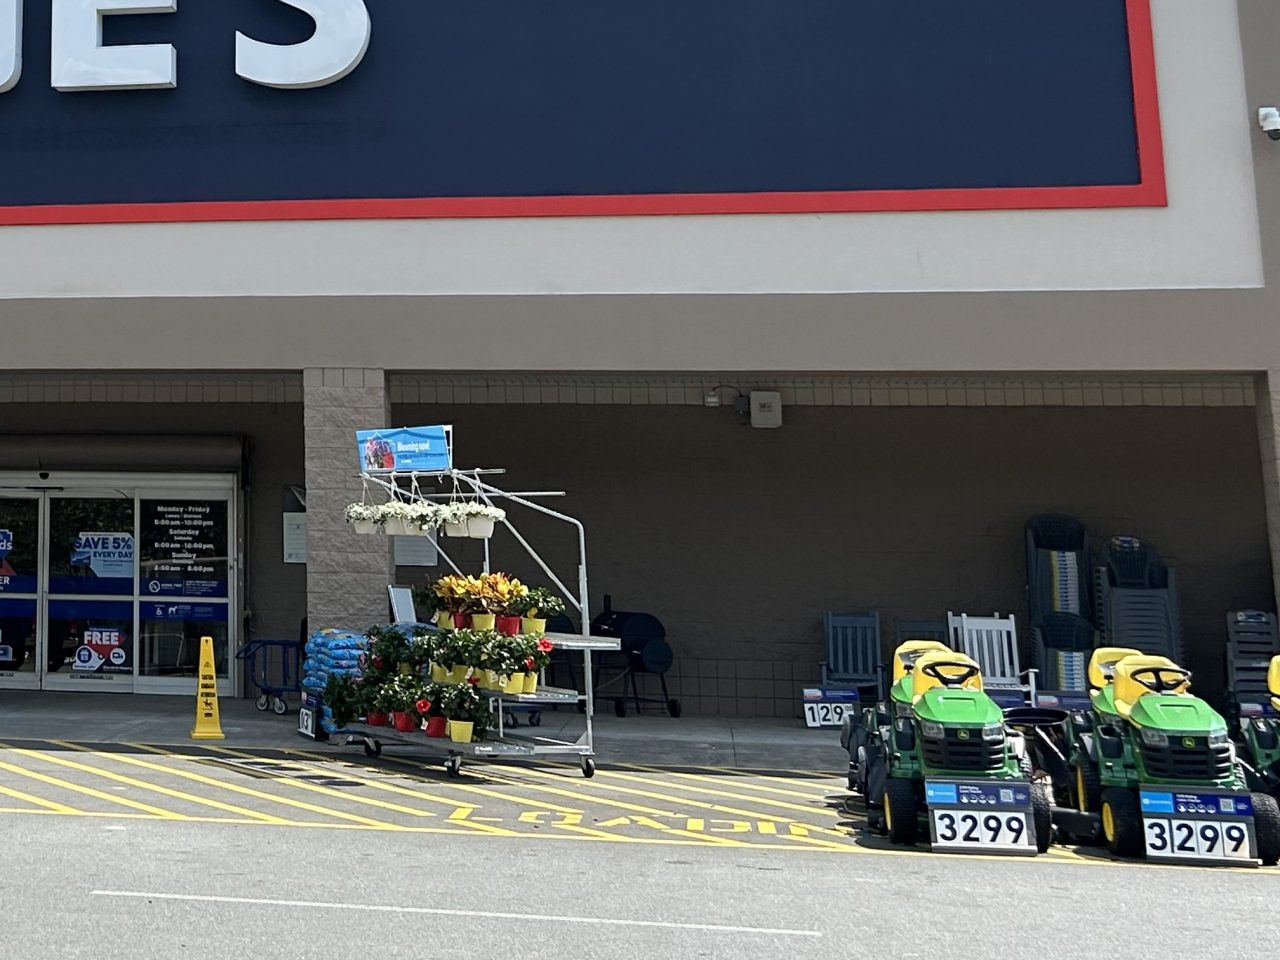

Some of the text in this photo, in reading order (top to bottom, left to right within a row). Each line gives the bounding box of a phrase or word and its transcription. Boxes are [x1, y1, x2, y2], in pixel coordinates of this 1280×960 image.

[75, 537, 132, 550] SAVE 5%
[117, 551, 133, 559] DAY
[84, 631, 119, 645] FREE
[808, 705, 844, 722] 129
[938, 813, 1024, 843] 3299
[1147, 822, 1245, 852] 3299
